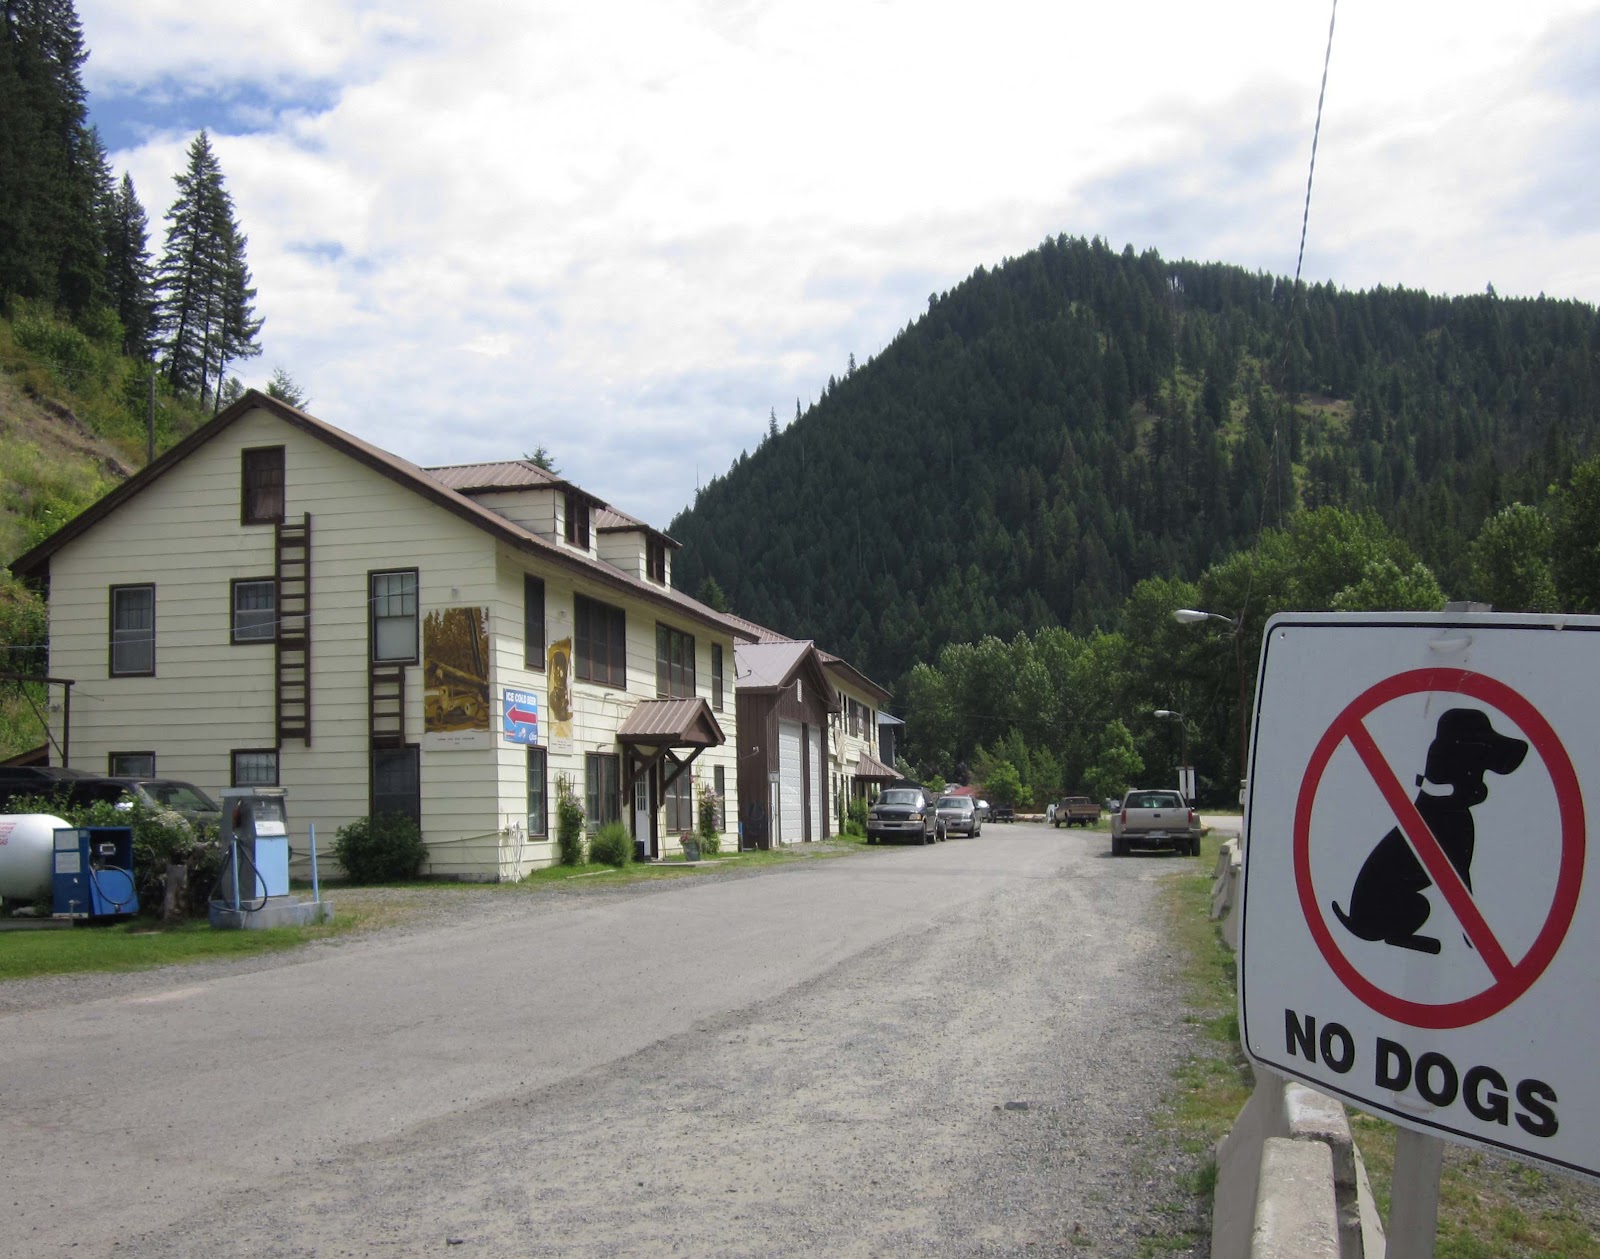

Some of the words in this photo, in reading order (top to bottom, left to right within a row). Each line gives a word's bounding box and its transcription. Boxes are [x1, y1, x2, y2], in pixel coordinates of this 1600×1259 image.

[506, 692, 514, 702] ICE
[515, 693, 526, 703] COLD
[527, 695, 536, 705] BEER
[1284, 1008, 1356, 1074] NO
[1375, 1037, 1559, 1138] DOGS
